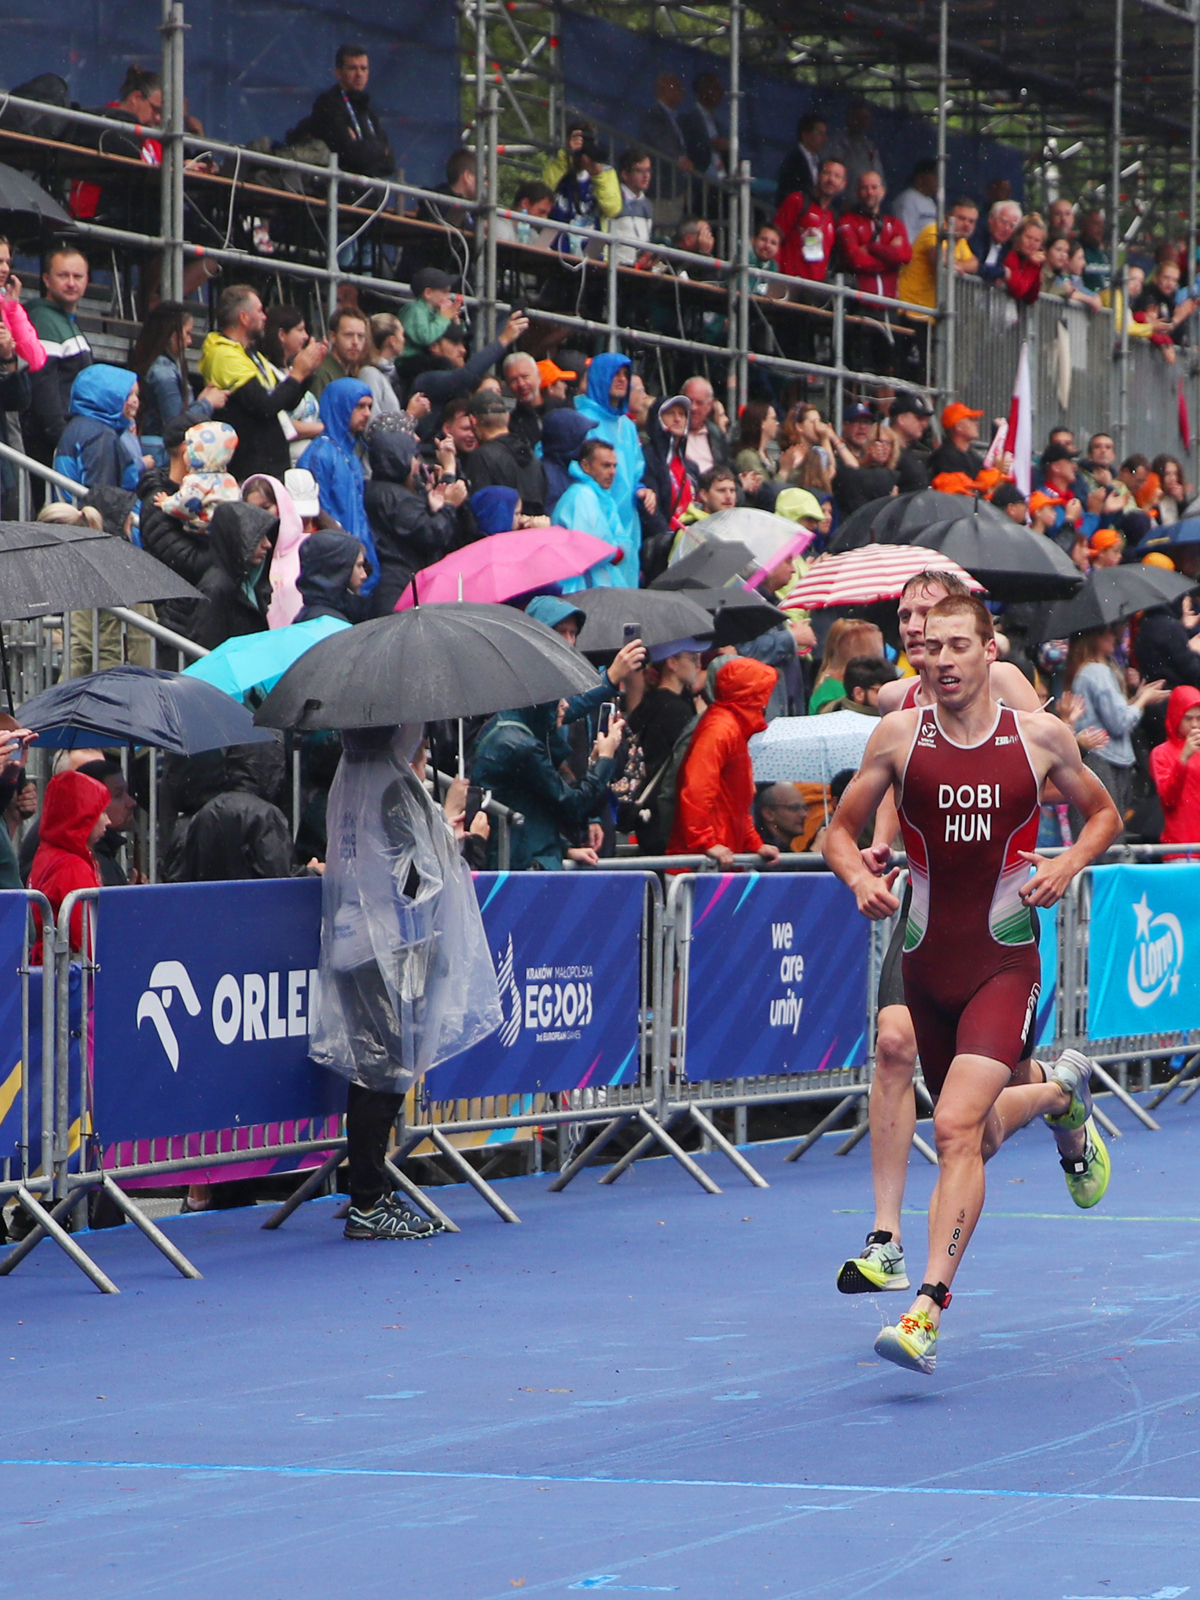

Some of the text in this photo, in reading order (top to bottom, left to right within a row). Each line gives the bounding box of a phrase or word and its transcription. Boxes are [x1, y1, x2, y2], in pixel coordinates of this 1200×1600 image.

[939, 784, 1000, 809] DOBI
[945, 813, 991, 842] HUN
[771, 922, 793, 949] we
[525, 964, 593, 980] KRAKÓW MAŁOPOLSKA
[780, 955, 804, 982] are
[770, 988, 803, 1034] unity
[952, 1227, 961, 1240] 8
[947, 1242, 957, 1257] C
